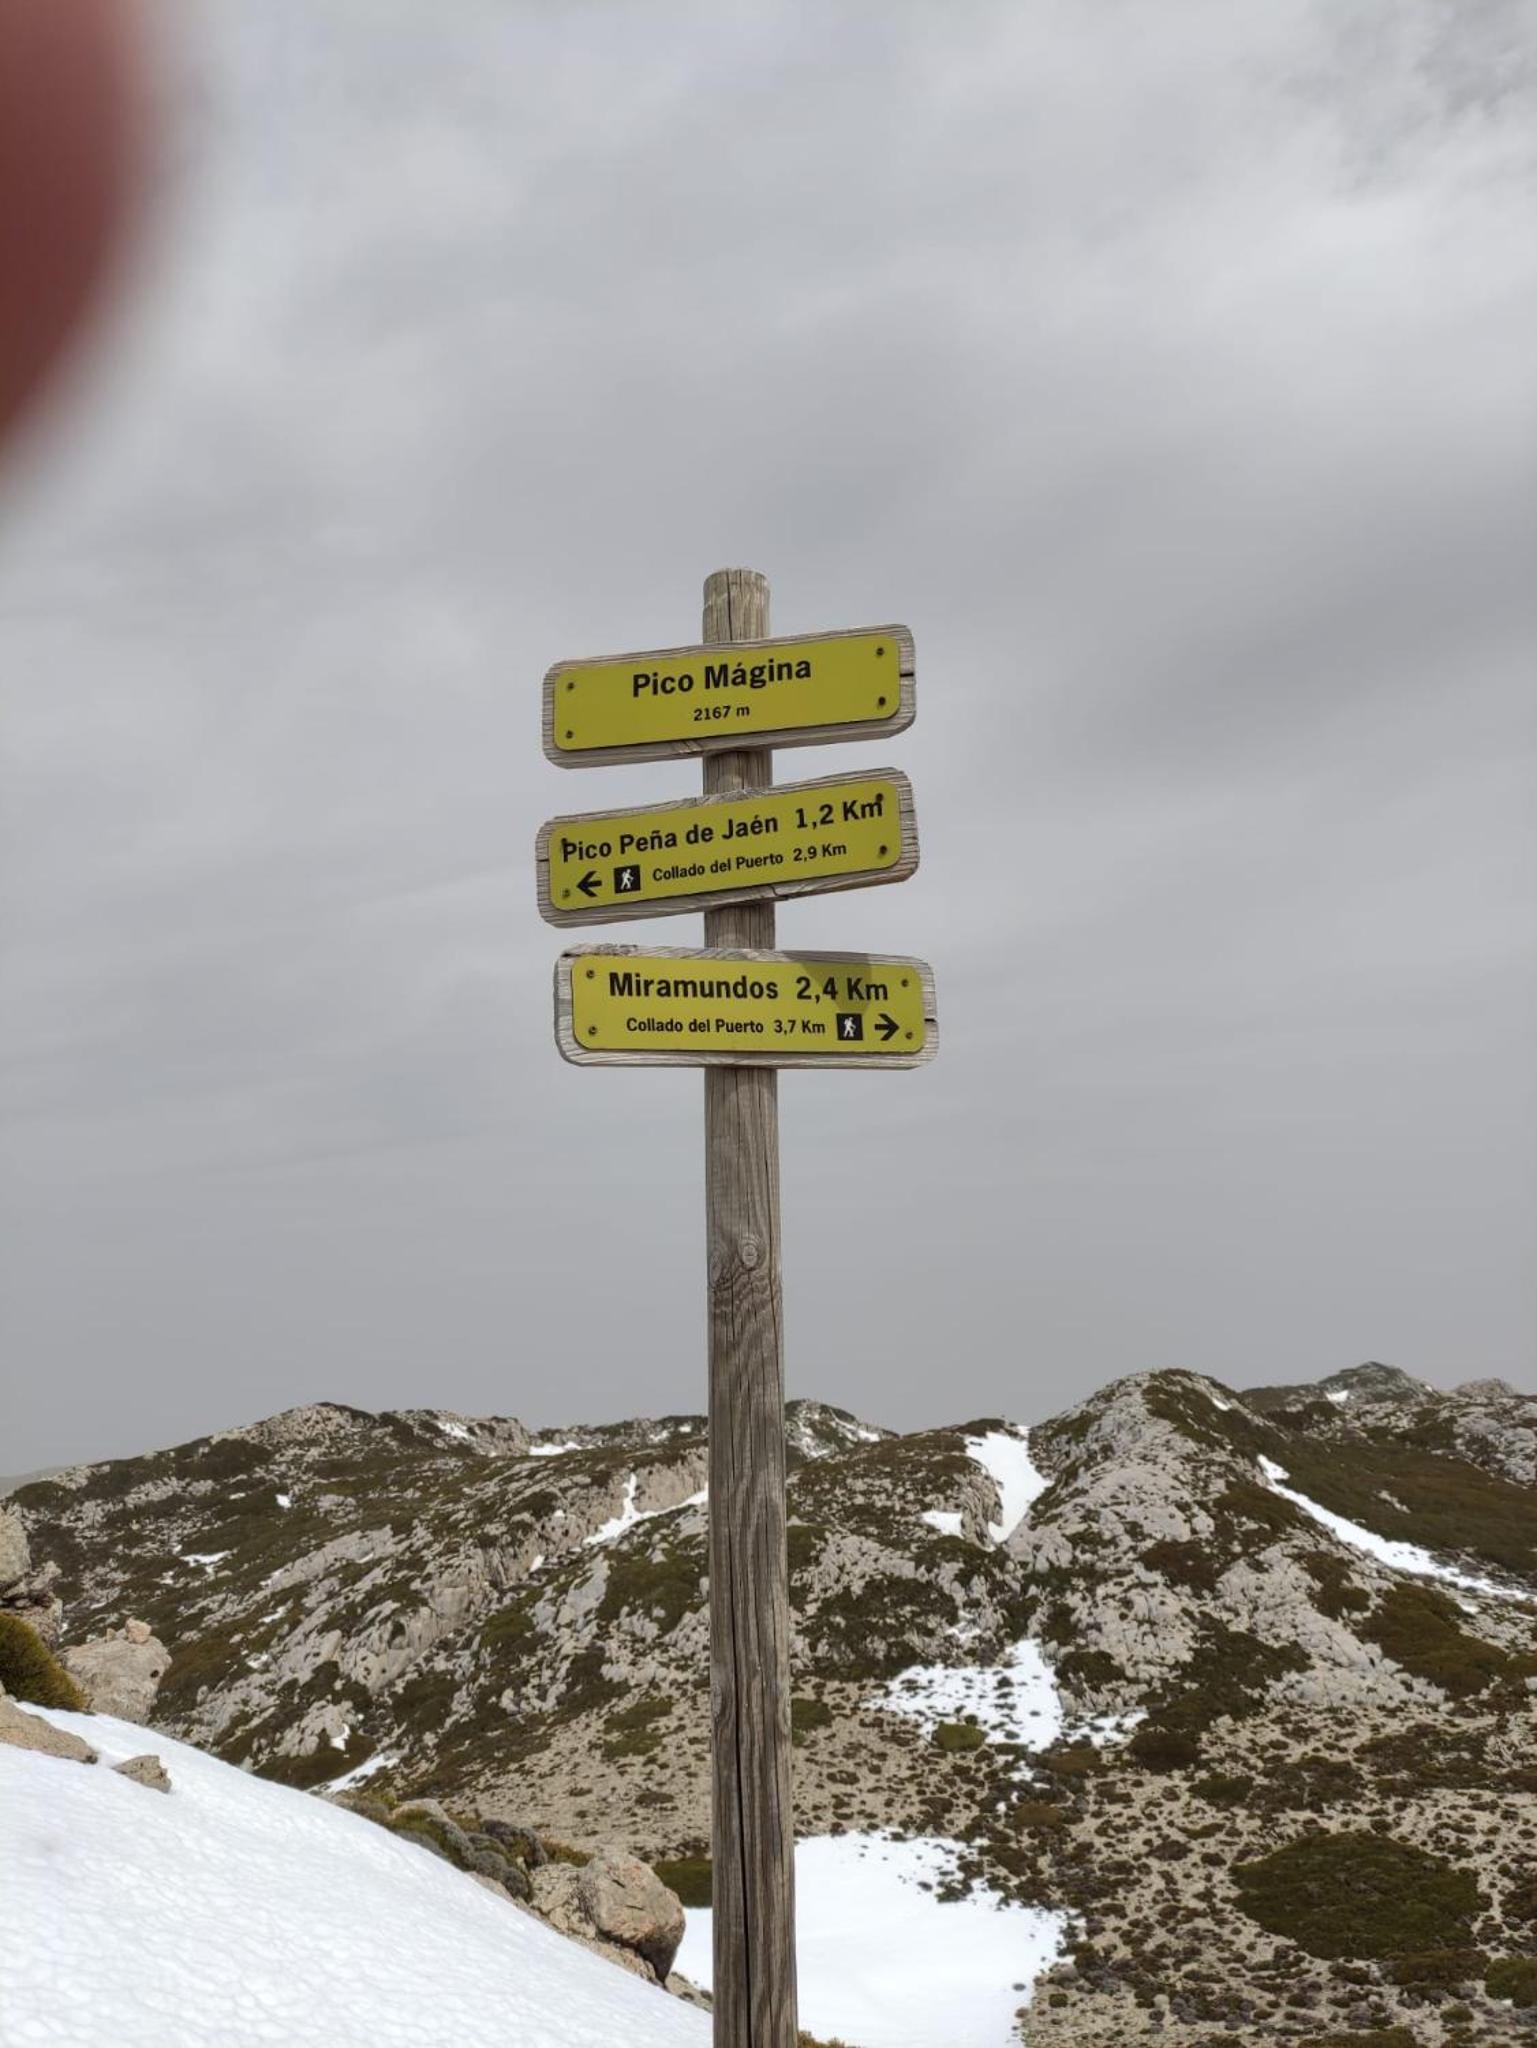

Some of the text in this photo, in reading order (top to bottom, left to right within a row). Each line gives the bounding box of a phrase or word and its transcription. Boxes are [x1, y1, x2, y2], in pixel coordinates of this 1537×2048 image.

[632, 657, 812, 697] Pico Mágina
[693, 705, 750, 722] 2167 m
[562, 798, 883, 862] Pico Peña de Jaén 1,2 Km
[652, 842, 847, 882] Collado del Puerto 2,9 Km
[608, 972, 889, 1004] Miramundos 2,4 Km
[626, 1017, 826, 1036] Collado del Puerto 3,7 Km
